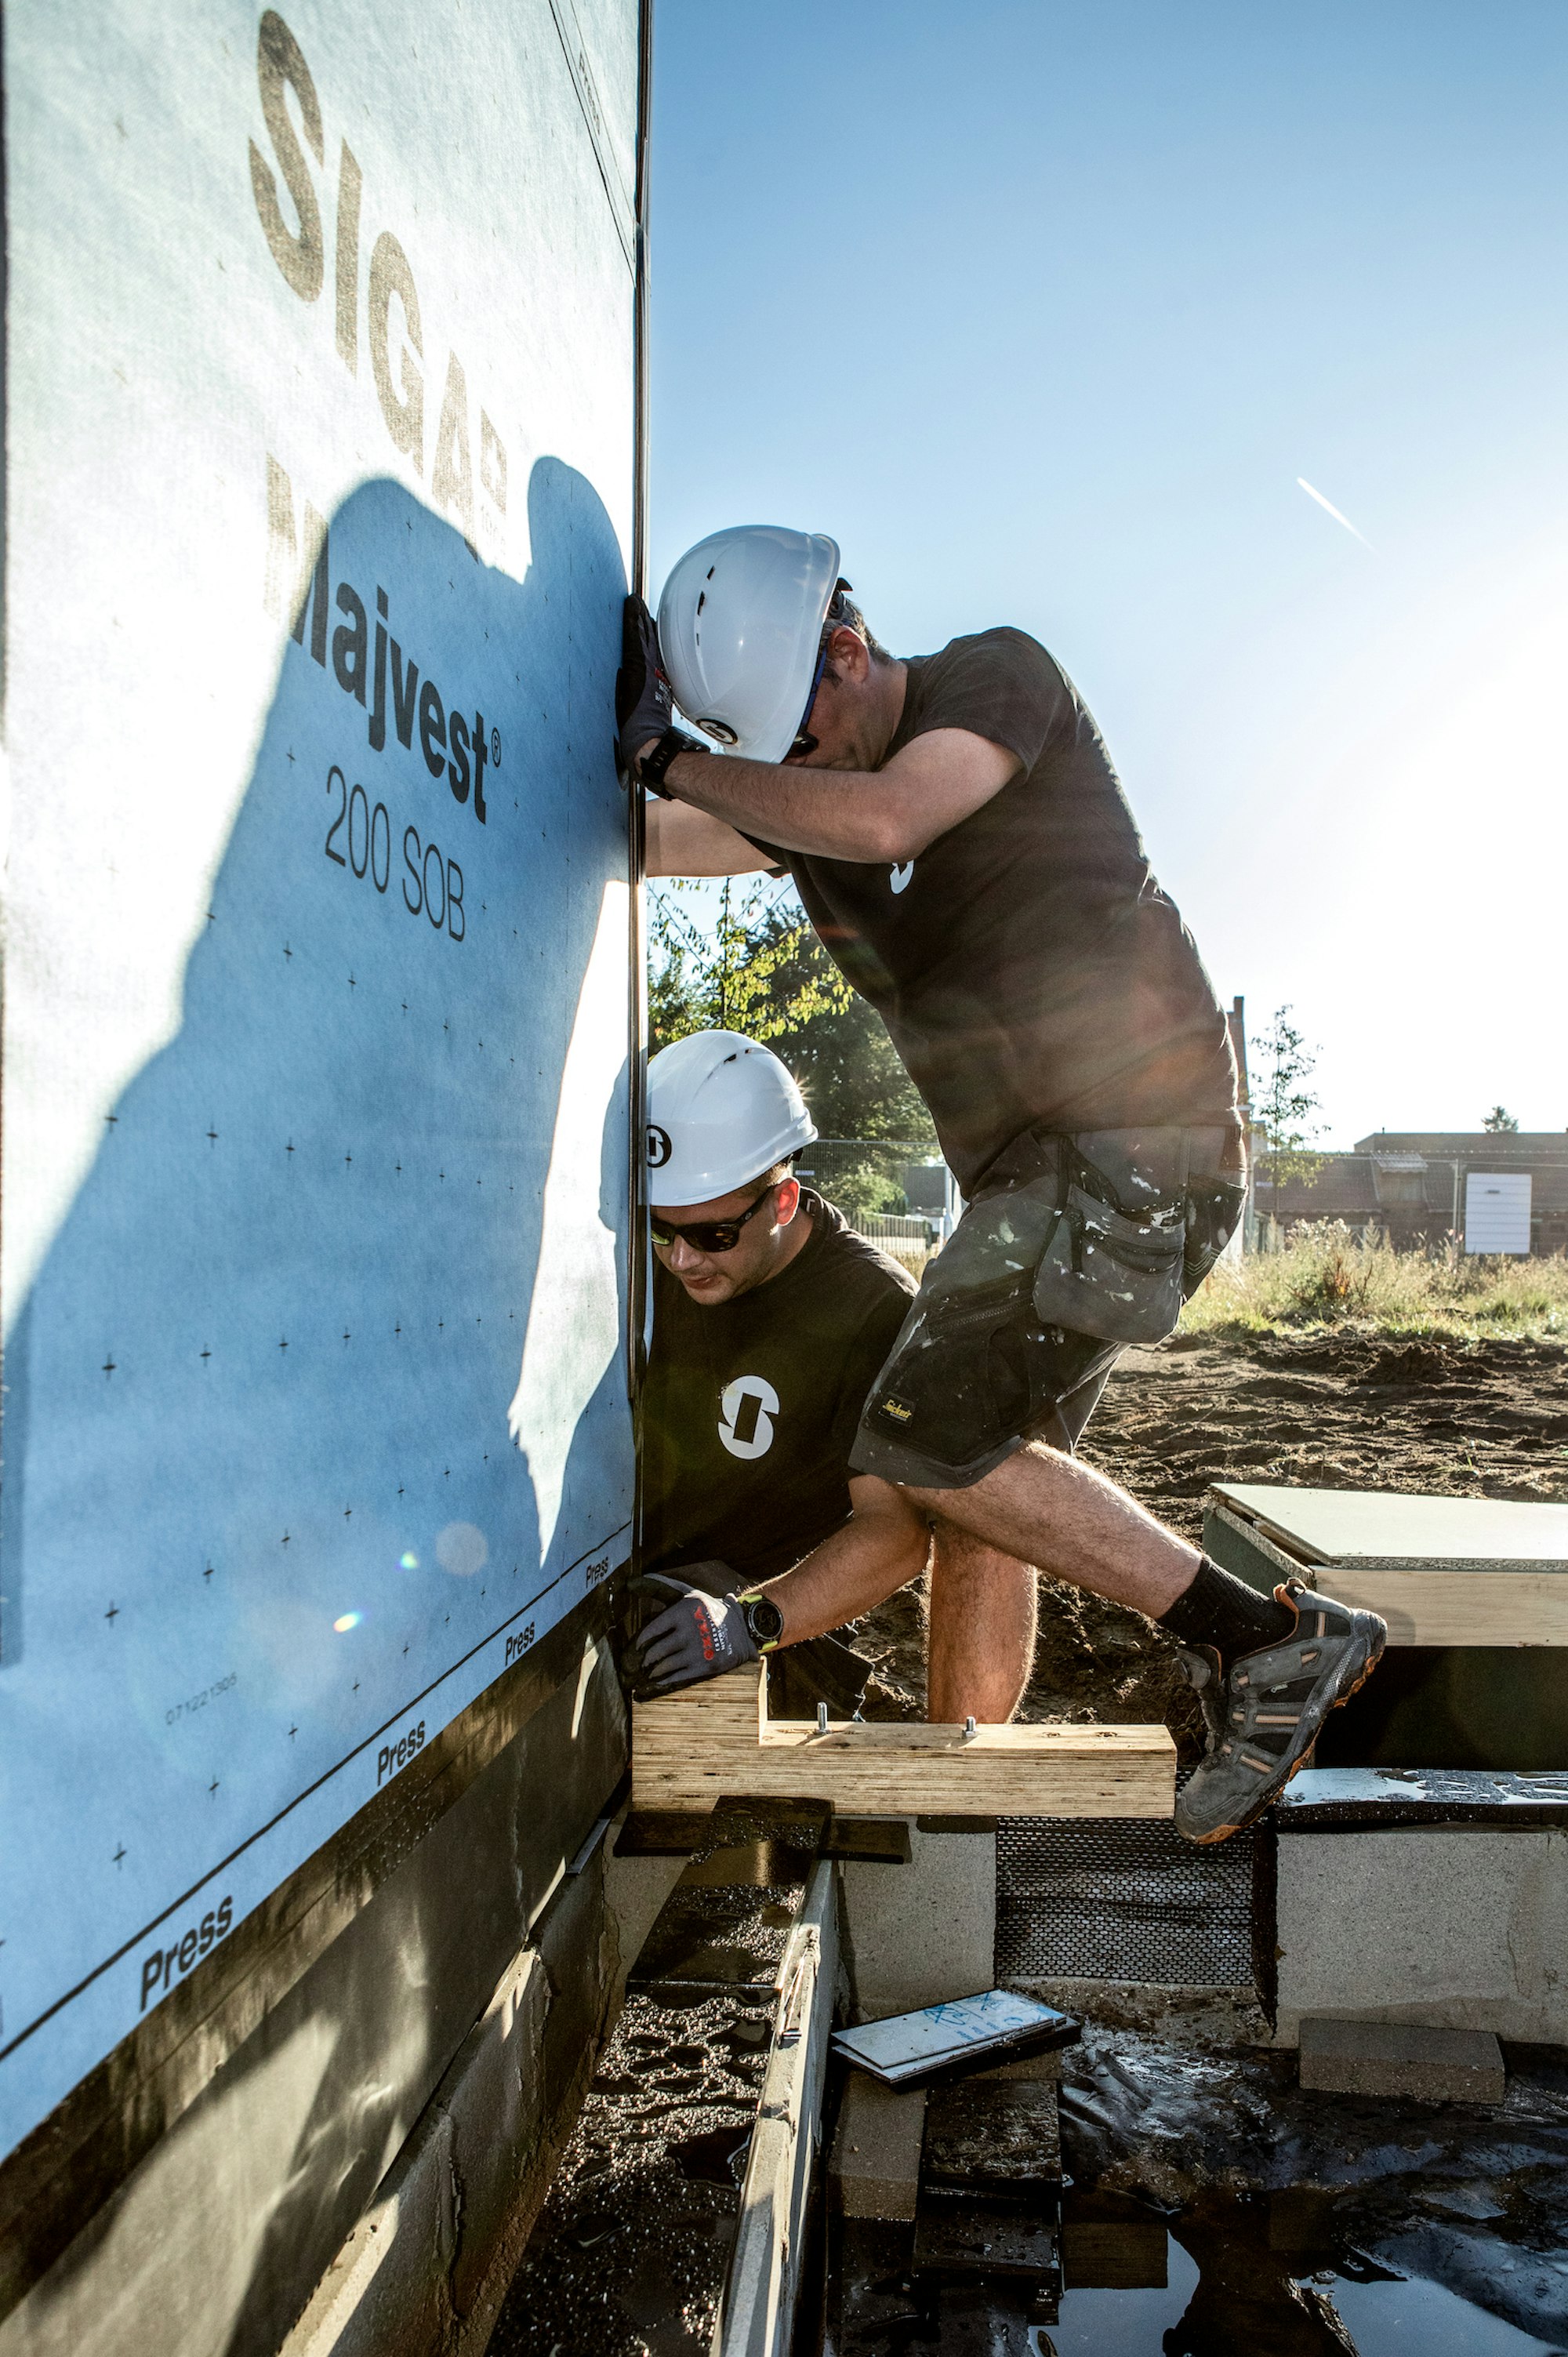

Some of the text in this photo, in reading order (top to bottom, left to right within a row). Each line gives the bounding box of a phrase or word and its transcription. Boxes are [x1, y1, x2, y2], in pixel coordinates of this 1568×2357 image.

[249, 9, 477, 565] SIGA
[325, 764, 465, 942] 200 SOB
[586, 1556, 608, 1589] Press
[506, 1621, 535, 1666] Press
[694, 1604, 714, 1662] OXXA
[377, 1720, 426, 1787] Press
[140, 1894, 233, 2012] Press
